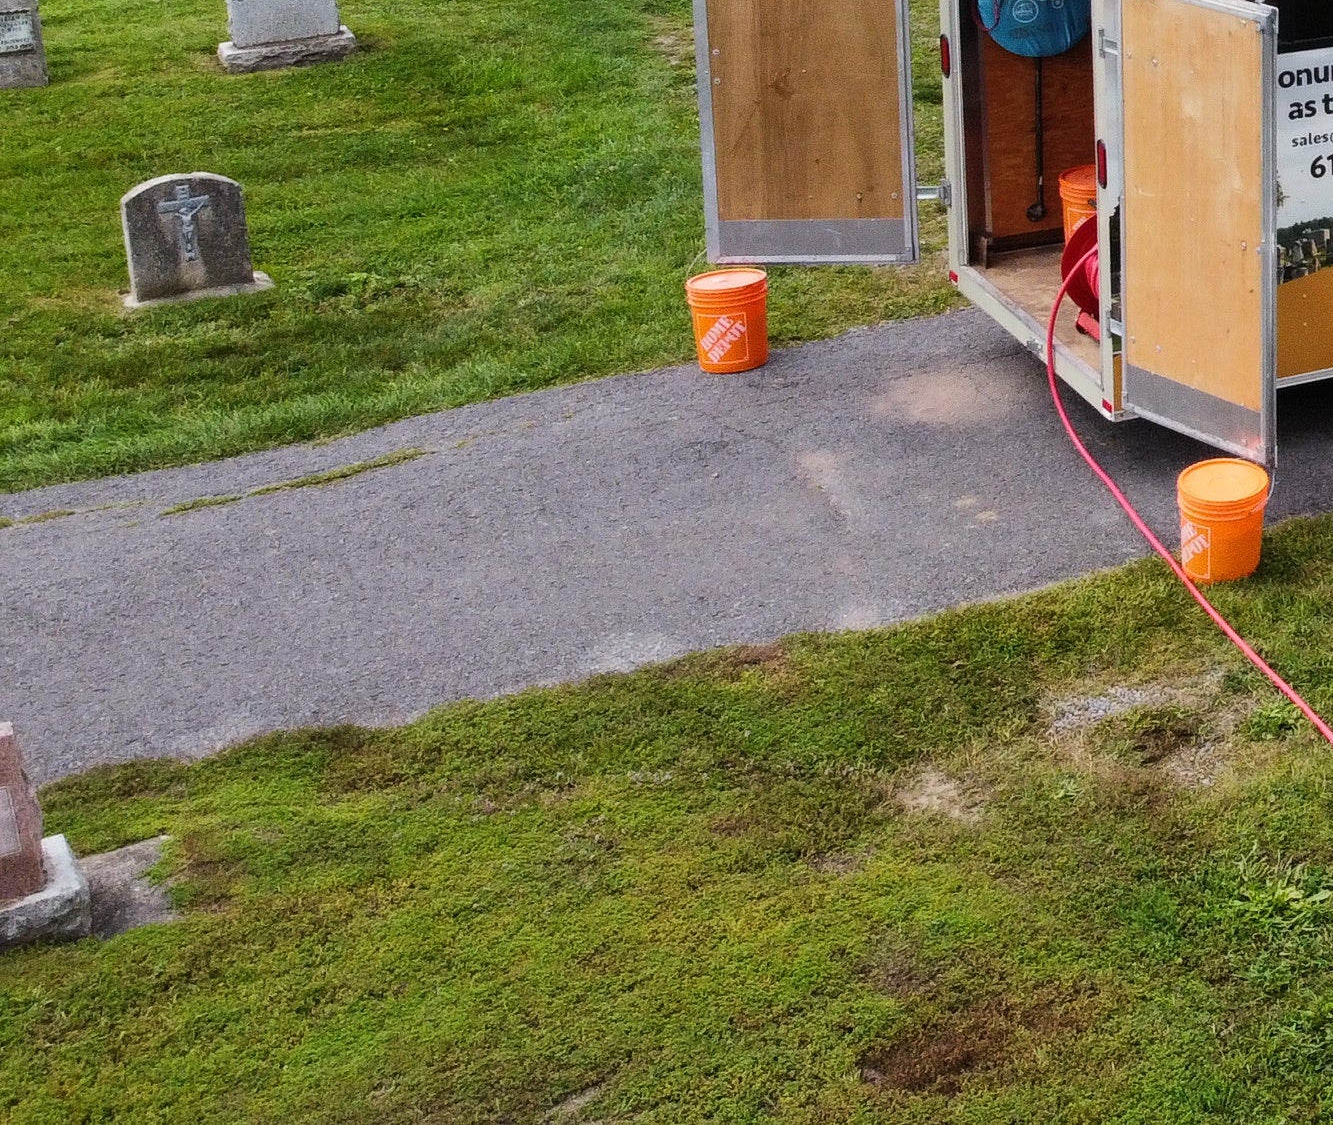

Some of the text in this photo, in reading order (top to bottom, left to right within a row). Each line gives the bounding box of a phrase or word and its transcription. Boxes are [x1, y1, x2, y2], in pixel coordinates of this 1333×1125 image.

[1288, 100, 1317, 120] as
[701, 315, 734, 352] HOME
[707, 320, 746, 363] DEPOT
